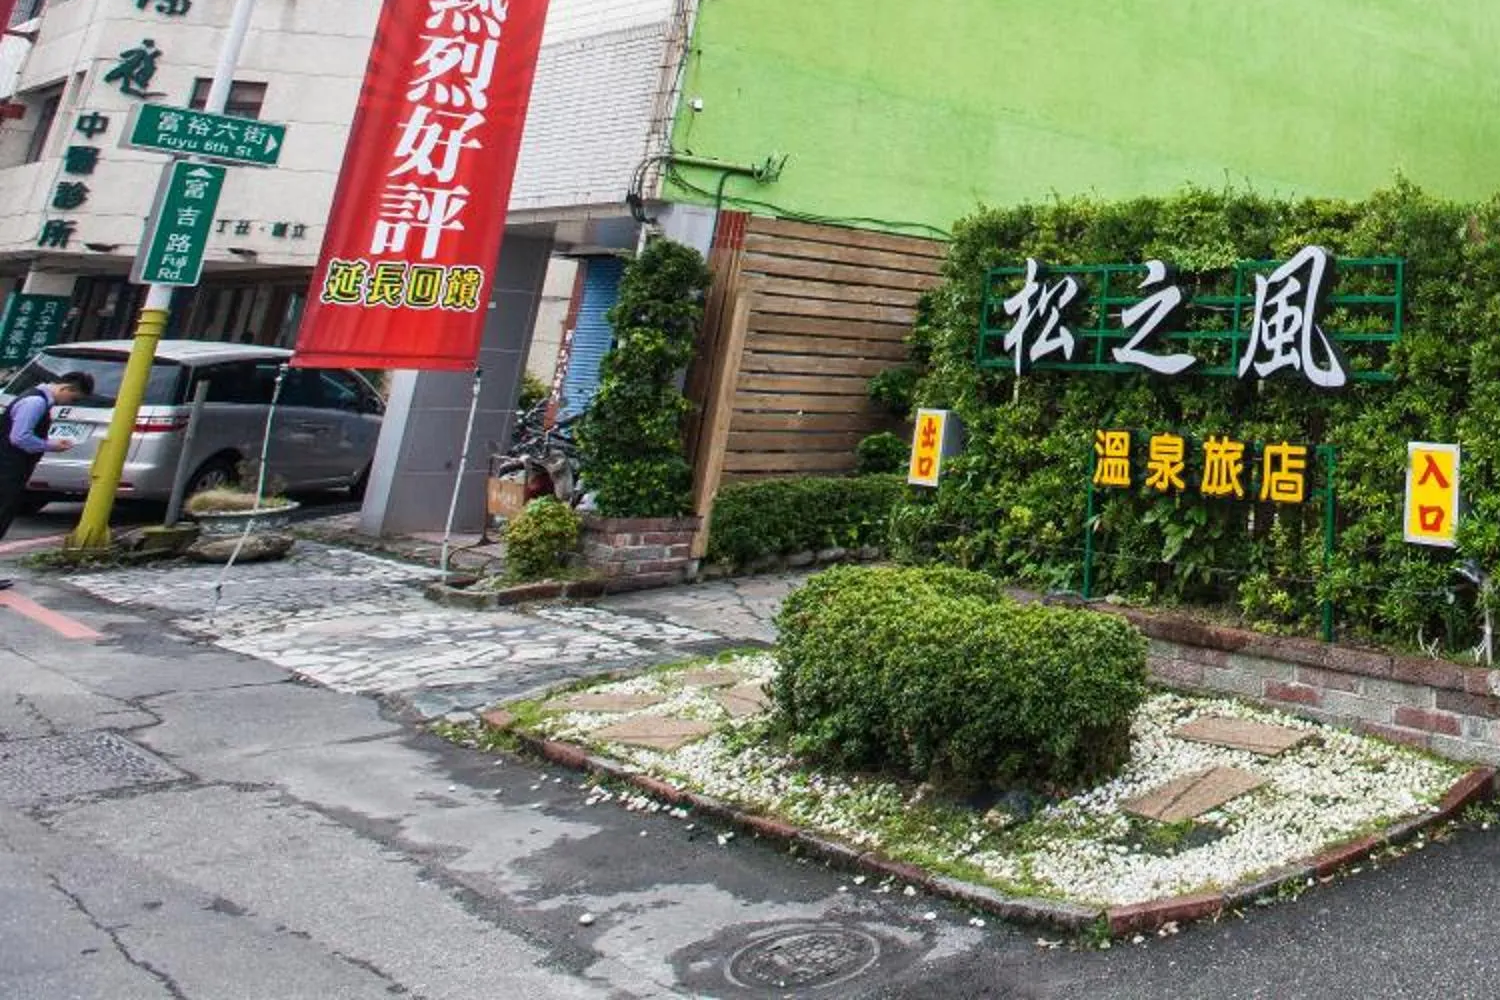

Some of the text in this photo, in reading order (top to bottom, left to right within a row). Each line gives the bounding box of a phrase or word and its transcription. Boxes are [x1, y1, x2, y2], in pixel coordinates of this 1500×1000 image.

[156, 111, 267, 145] 富裕六街
[157, 133, 198, 150] Fuyu
[166, 179, 209, 254] 富吉路
[156, 267, 184, 282] Rd.
[161, 253, 189, 273] Fuji
[322, 259, 484, 312] 延長回饋
[1003, 245, 1347, 388] 松之風
[917, 416, 937, 477] 出口
[1417, 453, 1450, 533] 入口
